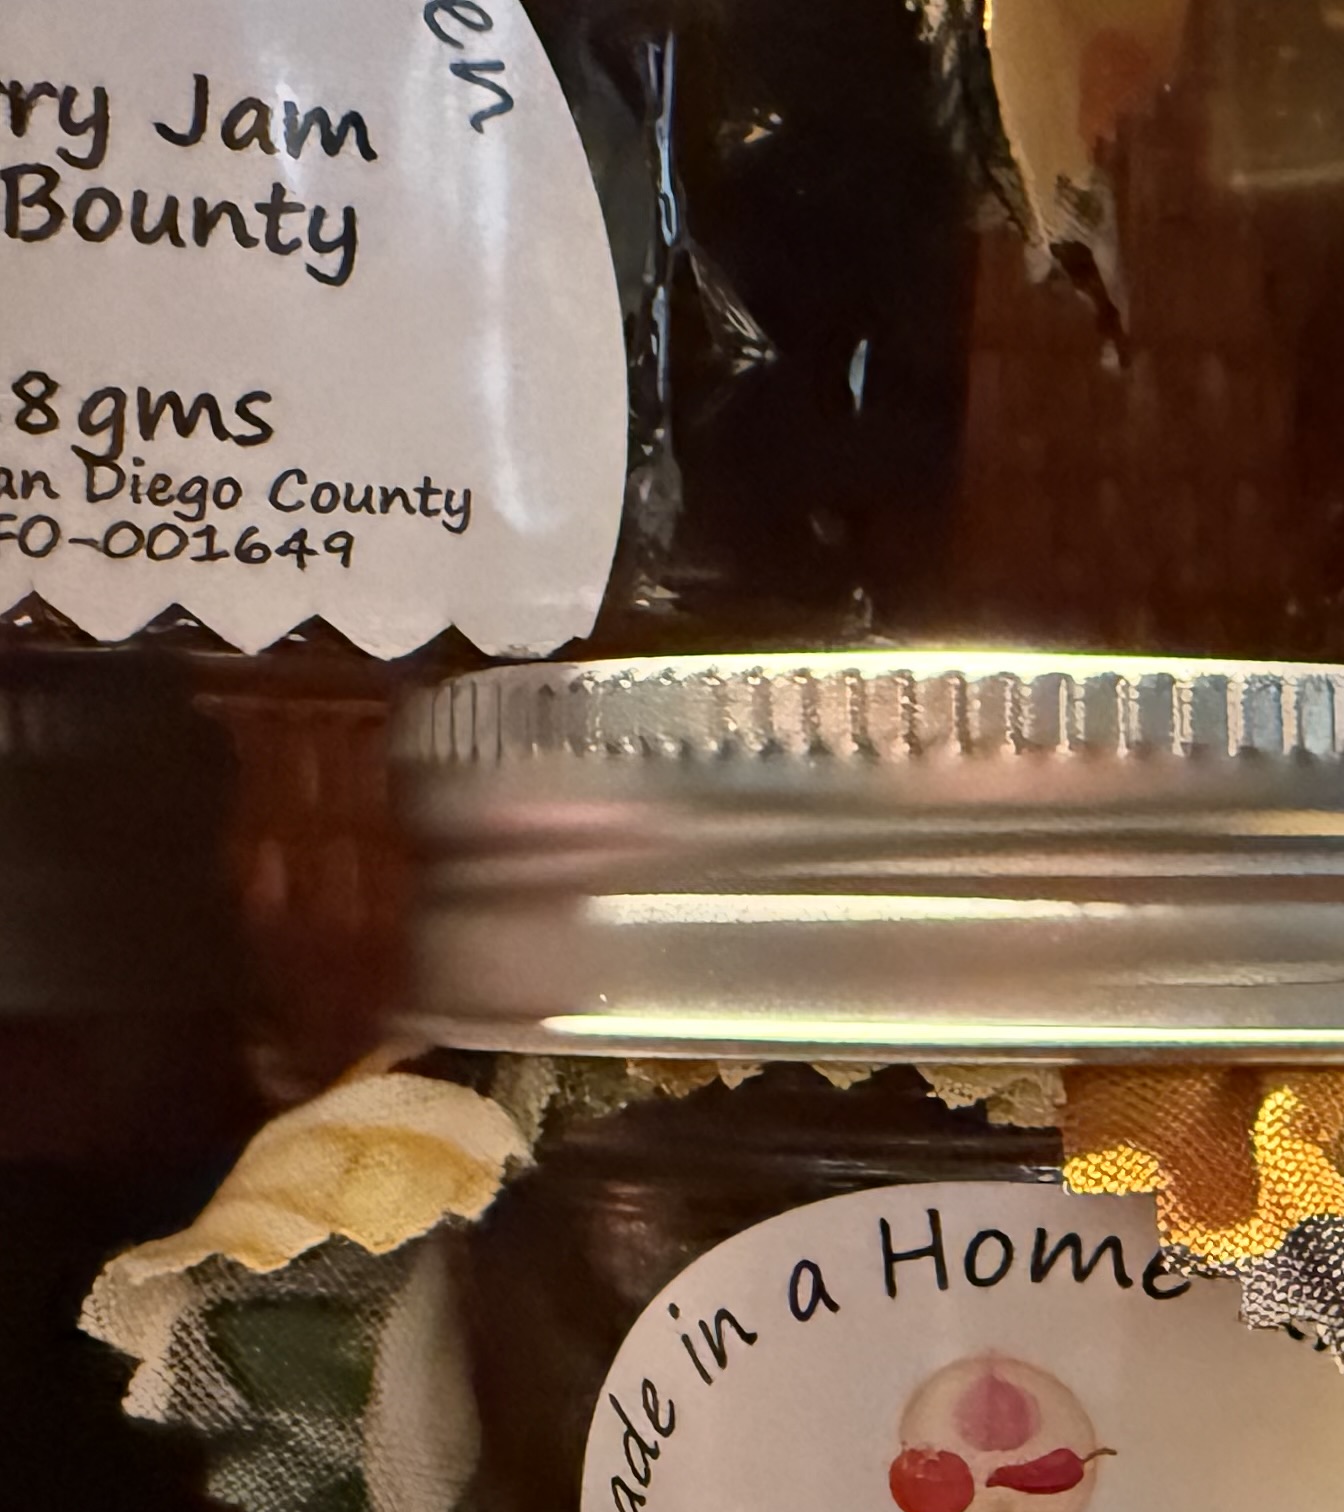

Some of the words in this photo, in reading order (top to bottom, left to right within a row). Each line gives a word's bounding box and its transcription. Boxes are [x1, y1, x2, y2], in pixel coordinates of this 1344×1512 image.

[154, 74, 378, 162] Jam
[0, 163, 358, 286] Bounty
[82, 456, 243, 521] Diego
[269, 467, 472, 534] County
[666, 1303, 758, 1384] in
[788, 1259, 840, 1324] a
